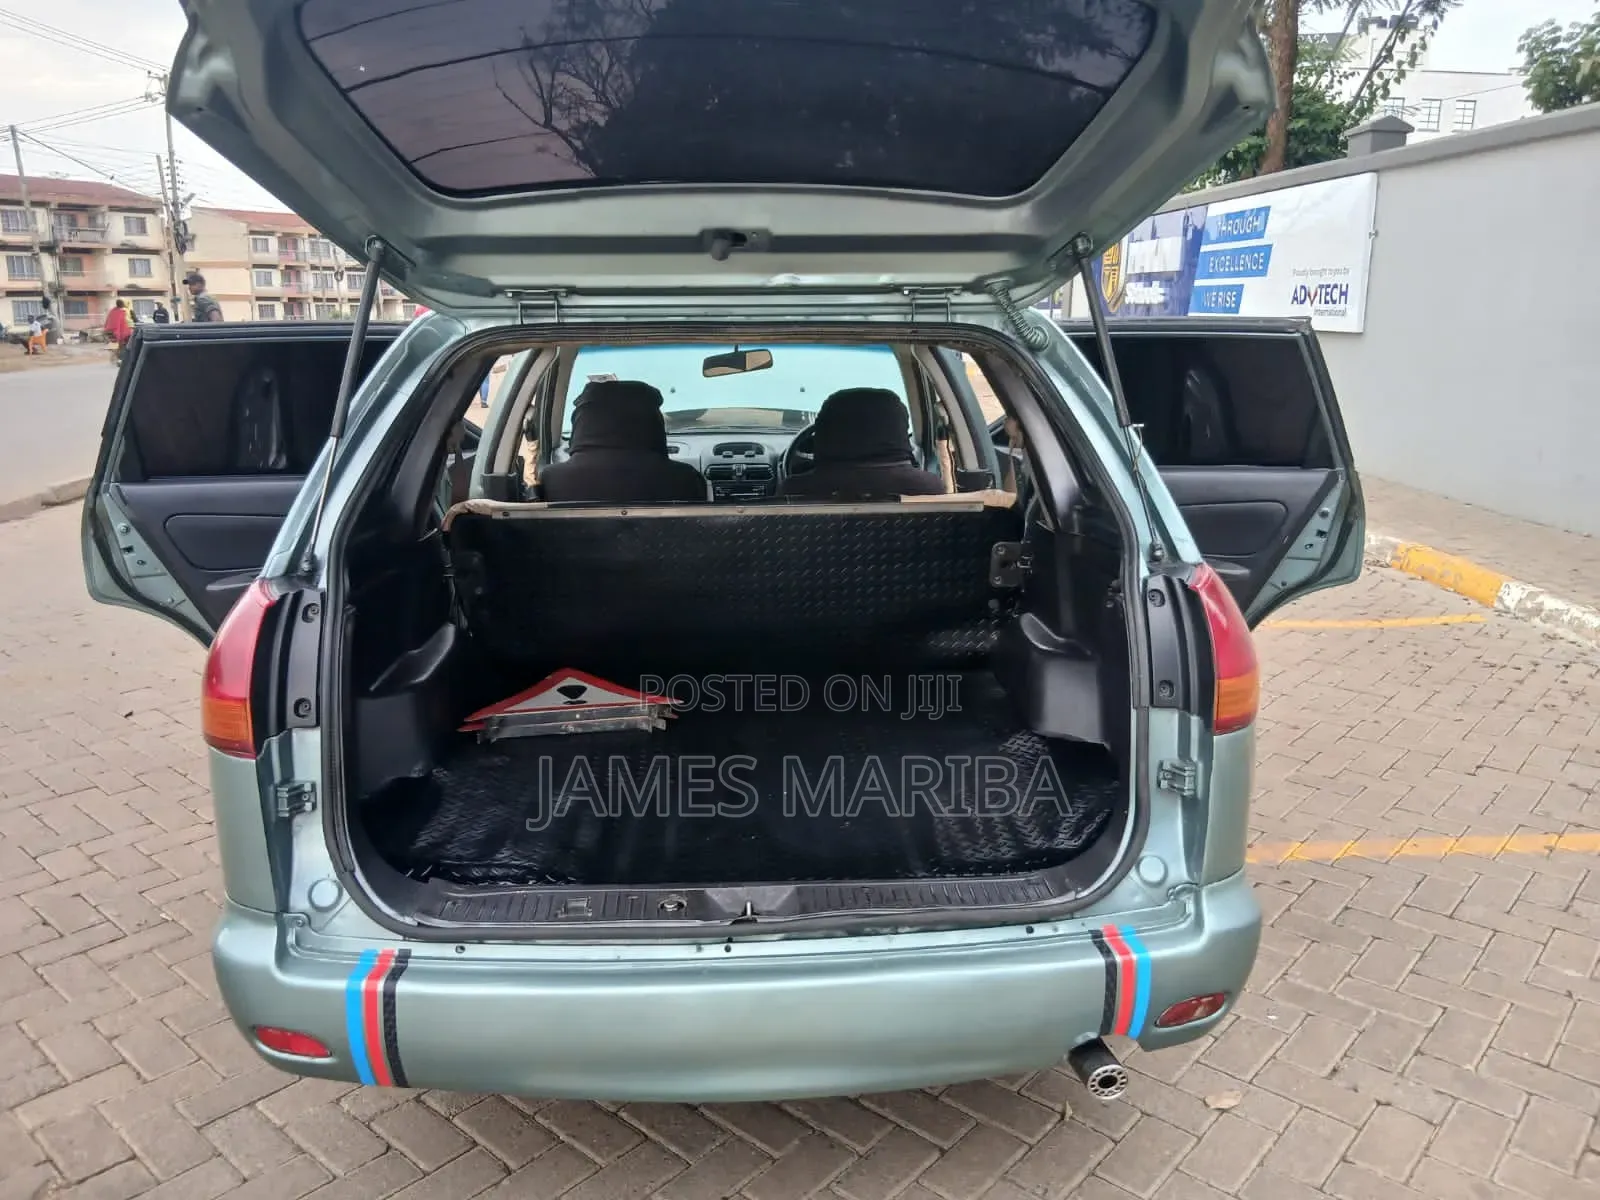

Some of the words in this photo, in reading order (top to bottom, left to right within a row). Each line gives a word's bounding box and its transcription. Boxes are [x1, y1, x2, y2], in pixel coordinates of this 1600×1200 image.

[1218, 215, 1260, 236] THROUGH
[1209, 252, 1264, 272] EXCELLENCE
[1203, 291, 1217, 308] WE
[1217, 291, 1237, 308] RISE
